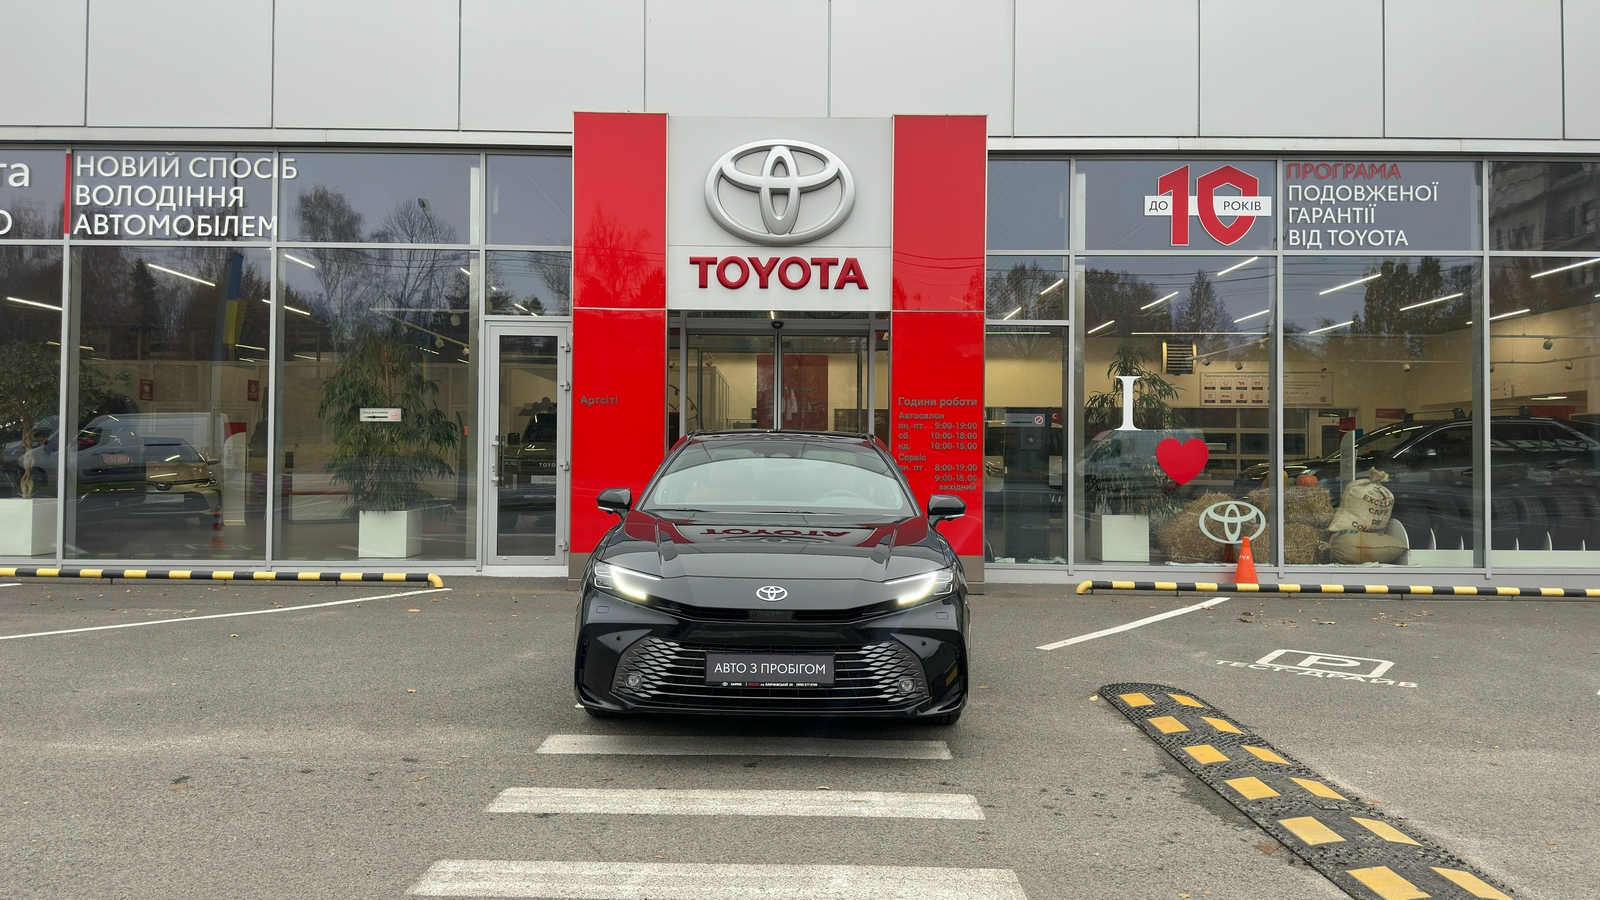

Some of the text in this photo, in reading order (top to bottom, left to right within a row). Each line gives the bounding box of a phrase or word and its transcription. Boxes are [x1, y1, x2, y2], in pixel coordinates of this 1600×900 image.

[76, 152, 298, 180] НОВИЙ СПОСІБ
[1286, 162, 1402, 180] ПРОГРАМА
[75, 184, 244, 211] ВОЛОДІННЯ
[1288, 181, 1439, 205] ПОДОВЖЕНОЇ
[1149, 164, 1262, 246] ДО 10 РОКІВ
[1288, 205, 1375, 224] ГАРАНТІЇ
[73, 213, 278, 237] АВТОМОБІЛЕМ
[1288, 229, 1409, 249] ВІД TOYOTA
[689, 256, 869, 290] TOYOTA
[580, 395, 618, 407] Артсіті
[898, 397, 977, 408] Години роботи
[898, 412, 944, 420] Автосалон
[934, 422, 977, 430] 9:00-19:00
[898, 432, 977, 440] сб. 10:00-18:00
[930, 442, 977, 450] 10:00-15:00
[898, 454, 926, 462] Сервіс
[934, 464, 977, 472] 8:00-19:00
[939, 484, 977, 492] вихідний
[1297, 655, 1361, 668] P
[714, 662, 747, 674] АВТО
[760, 663, 826, 675] ПРОБІГОМ
[1215, 659, 1419, 688] ТЕСТ-ДРАЙВ
